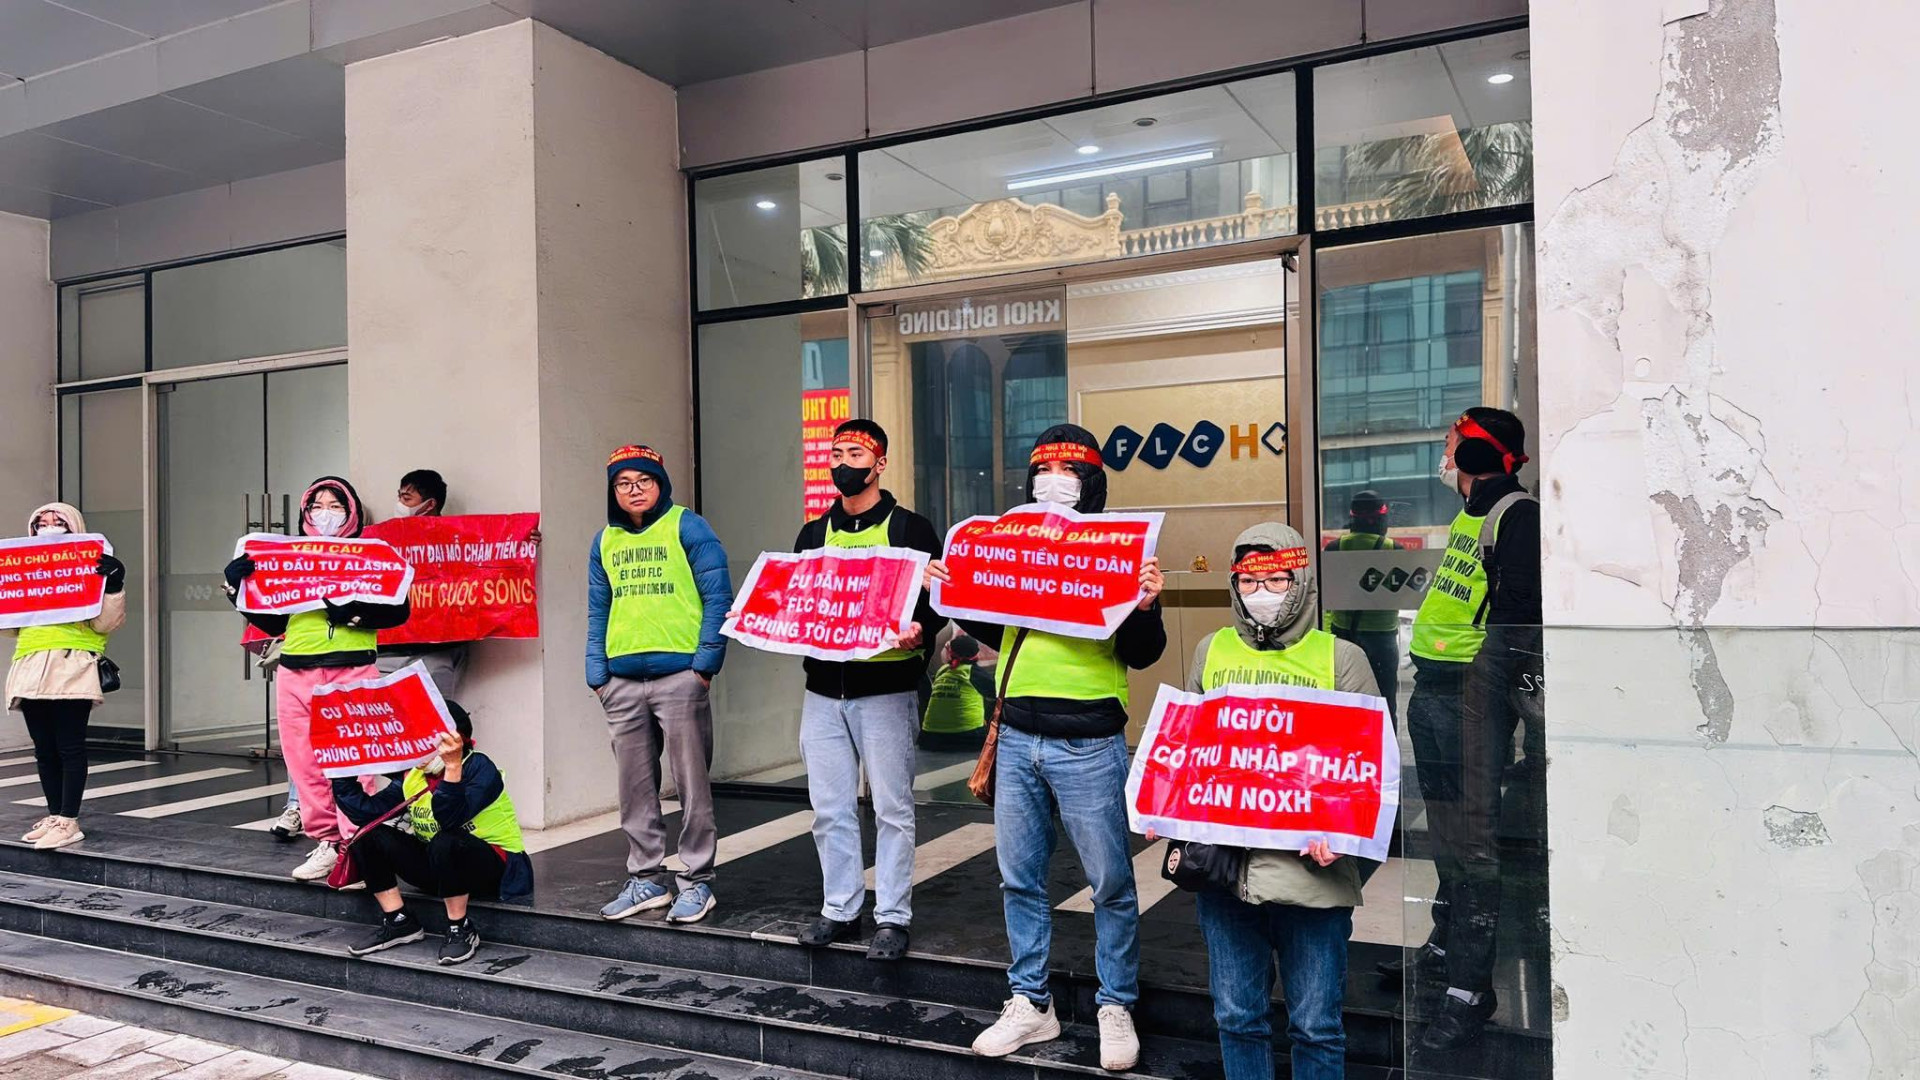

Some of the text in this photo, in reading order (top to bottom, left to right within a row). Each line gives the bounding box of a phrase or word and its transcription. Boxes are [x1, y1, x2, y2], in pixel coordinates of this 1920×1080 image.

[344, 560, 402, 571] ALASKA
[648, 566, 663, 578] FLC
[974, 544, 1017, 563] DỤNG
[1063, 554, 1092, 570] CƯ
[1095, 555, 1133, 575] DÂN
[973, 570, 1104, 599] ĐÚNG MỤC ĐÍCH
[787, 596, 815, 614] FLC
[336, 722, 363, 738] FLC
[1217, 703, 1294, 735] NGƯỜI
[1153, 744, 1377, 783] CÓ THU NHẬP THẤP
[1188, 774, 1312, 814] CẦN NOXH
